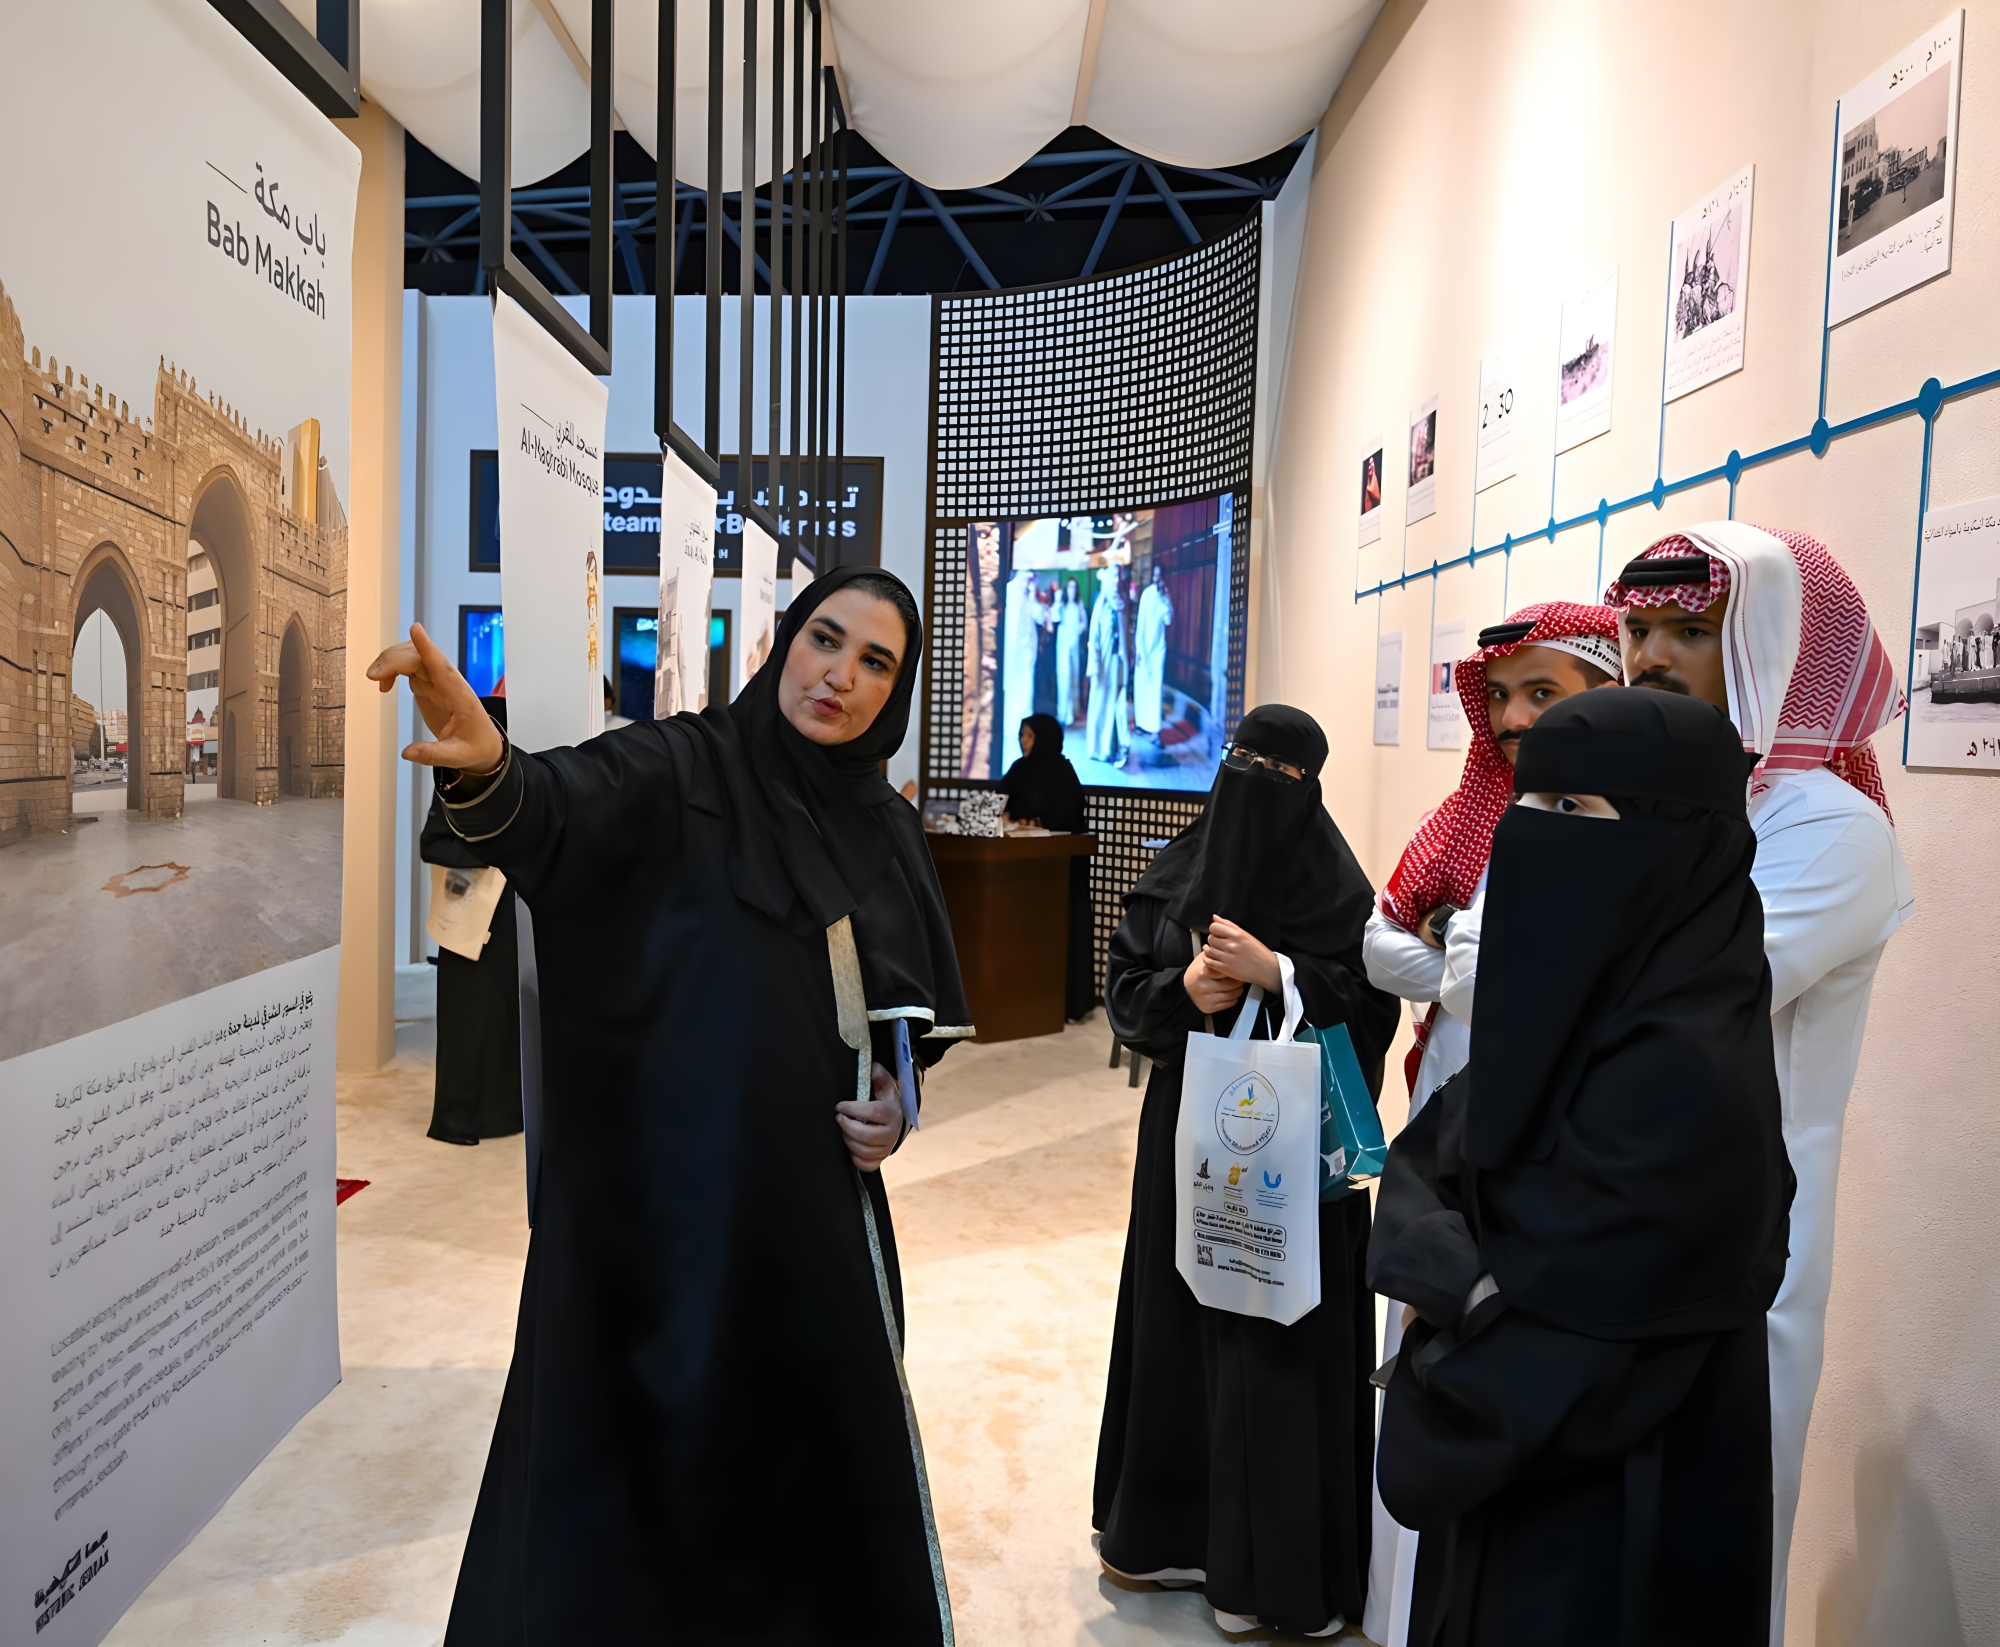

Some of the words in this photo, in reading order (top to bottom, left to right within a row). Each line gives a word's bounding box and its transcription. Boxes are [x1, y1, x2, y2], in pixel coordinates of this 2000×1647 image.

[255, 162, 291, 230] مكة
[207, 200, 249, 266] Bab
[256, 235, 325, 320] Makkah
[296, 213, 325, 268] باب
